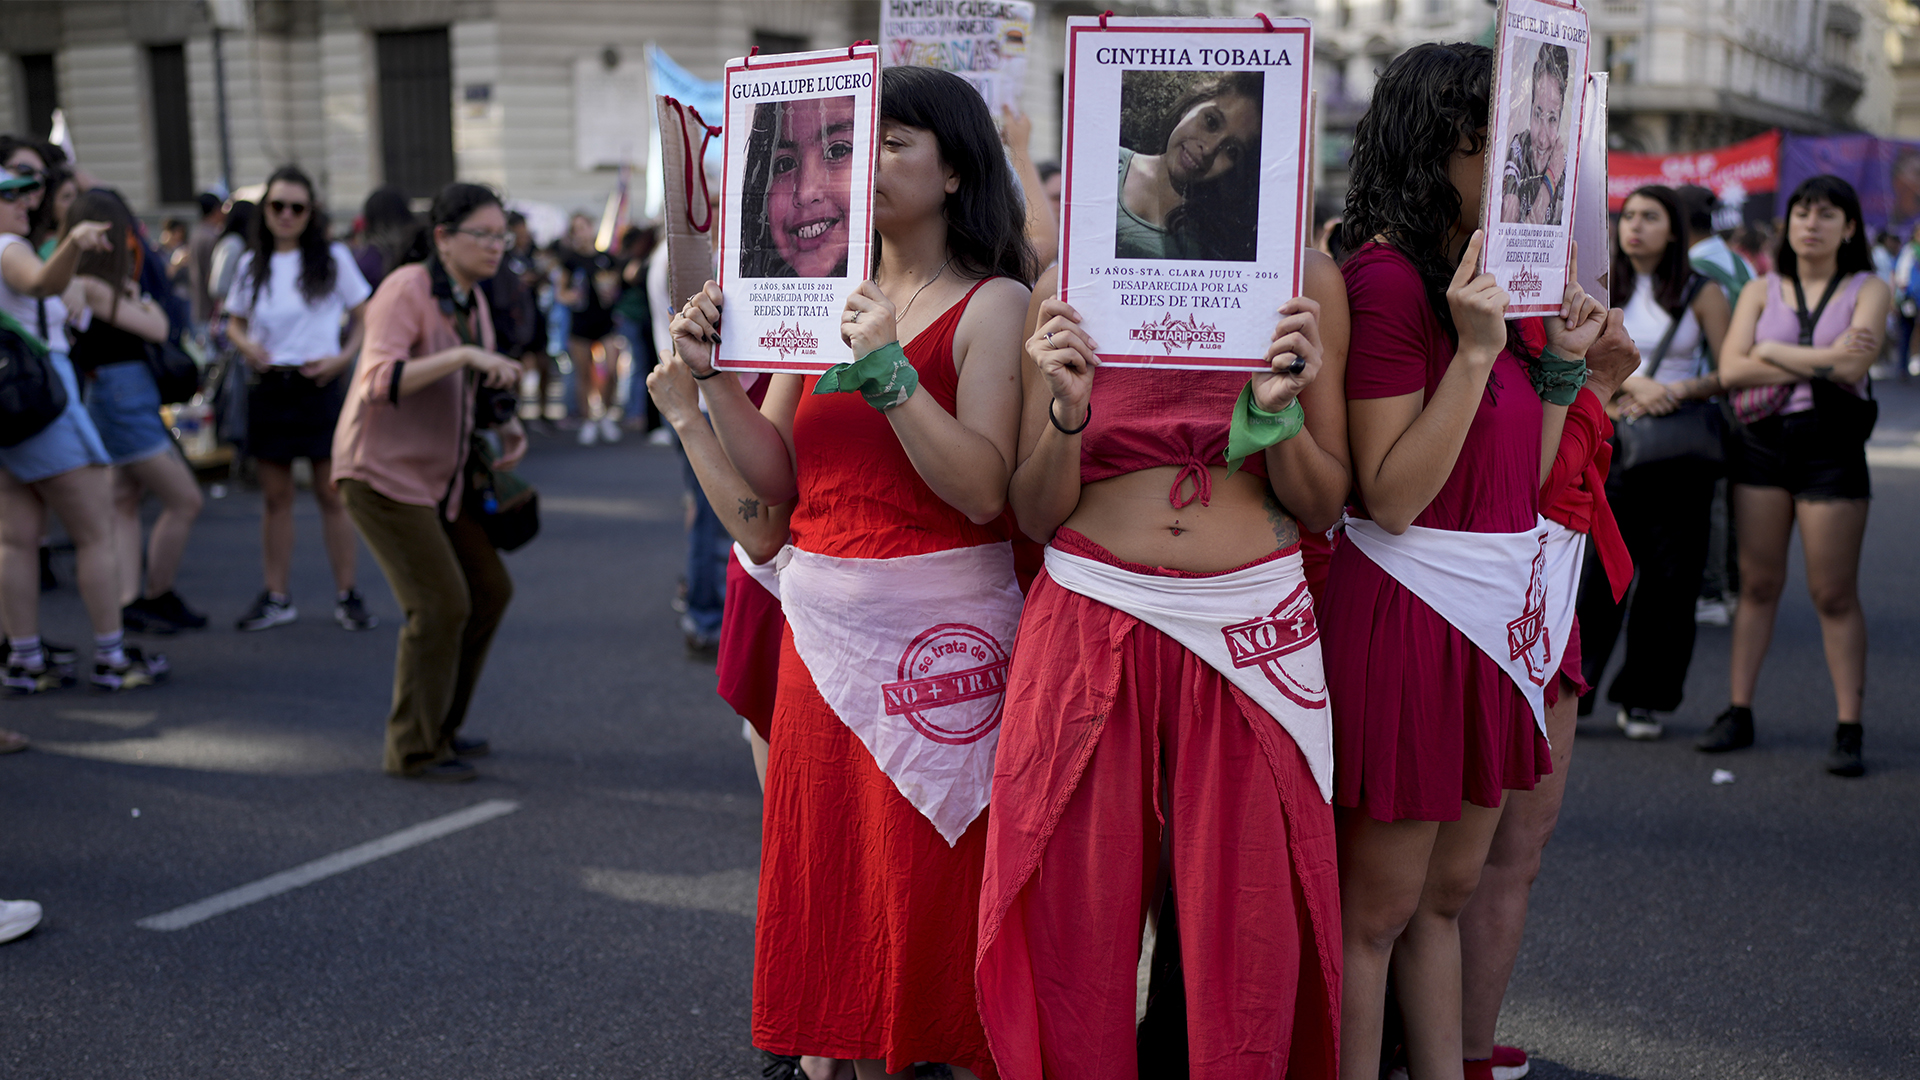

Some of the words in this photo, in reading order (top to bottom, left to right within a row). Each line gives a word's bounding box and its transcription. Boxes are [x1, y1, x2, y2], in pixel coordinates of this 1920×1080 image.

[1507, 12, 1538, 33] TEHUEL
[1540, 20, 1549, 36] DE
[1550, 22, 1560, 38] LA
[1562, 25, 1587, 44] TORRE
[888, 39, 1002, 71] VEGANAS
[1096, 47, 1193, 65] CINTHIA
[1199, 49, 1292, 66] TOBALA
[732, 78, 815, 99] GUADALUPE
[818, 72, 872, 92] LUCERO
[1505, 251, 1524, 262] REDES
[1532, 252, 1549, 263] TRATA
[1090, 267, 1100, 275] 15
[1105, 266, 1164, 276] AÑOS-STA.
[1169, 269, 1205, 277] CLARA
[1209, 270, 1242, 279] JUJUY
[1255, 272, 1279, 280] 2016
[759, 282, 780, 291] AÑOS,
[1112, 280, 1198, 292] DESAPARECIDA
[1201, 282, 1224, 292] POR
[1227, 283, 1248, 293] LAS
[749, 293, 802, 302] DESAPARECIDA
[804, 293, 819, 302] POR
[820, 293, 834, 302] LAS
[1120, 294, 1165, 307] REDES
[1169, 295, 1188, 308] DE
[1192, 296, 1242, 309] TRATA
[754, 305, 781, 316] REDES
[783, 306, 795, 316] DE
[797, 305, 829, 316] TRATA
[759, 338, 773, 347] LAS
[775, 338, 818, 348] MARIPOSAS
[1130, 330, 1153, 340] LAS
[1156, 330, 1224, 342] MARIPOSAS
[1229, 624, 1277, 657] NO
[1291, 617, 1306, 638] +
[1511, 619, 1535, 652] NO
[918, 655, 934, 674] se
[932, 640, 967, 658] trata
[971, 644, 987, 662] de
[886, 686, 918, 708] NO
[928, 684, 942, 700] +
